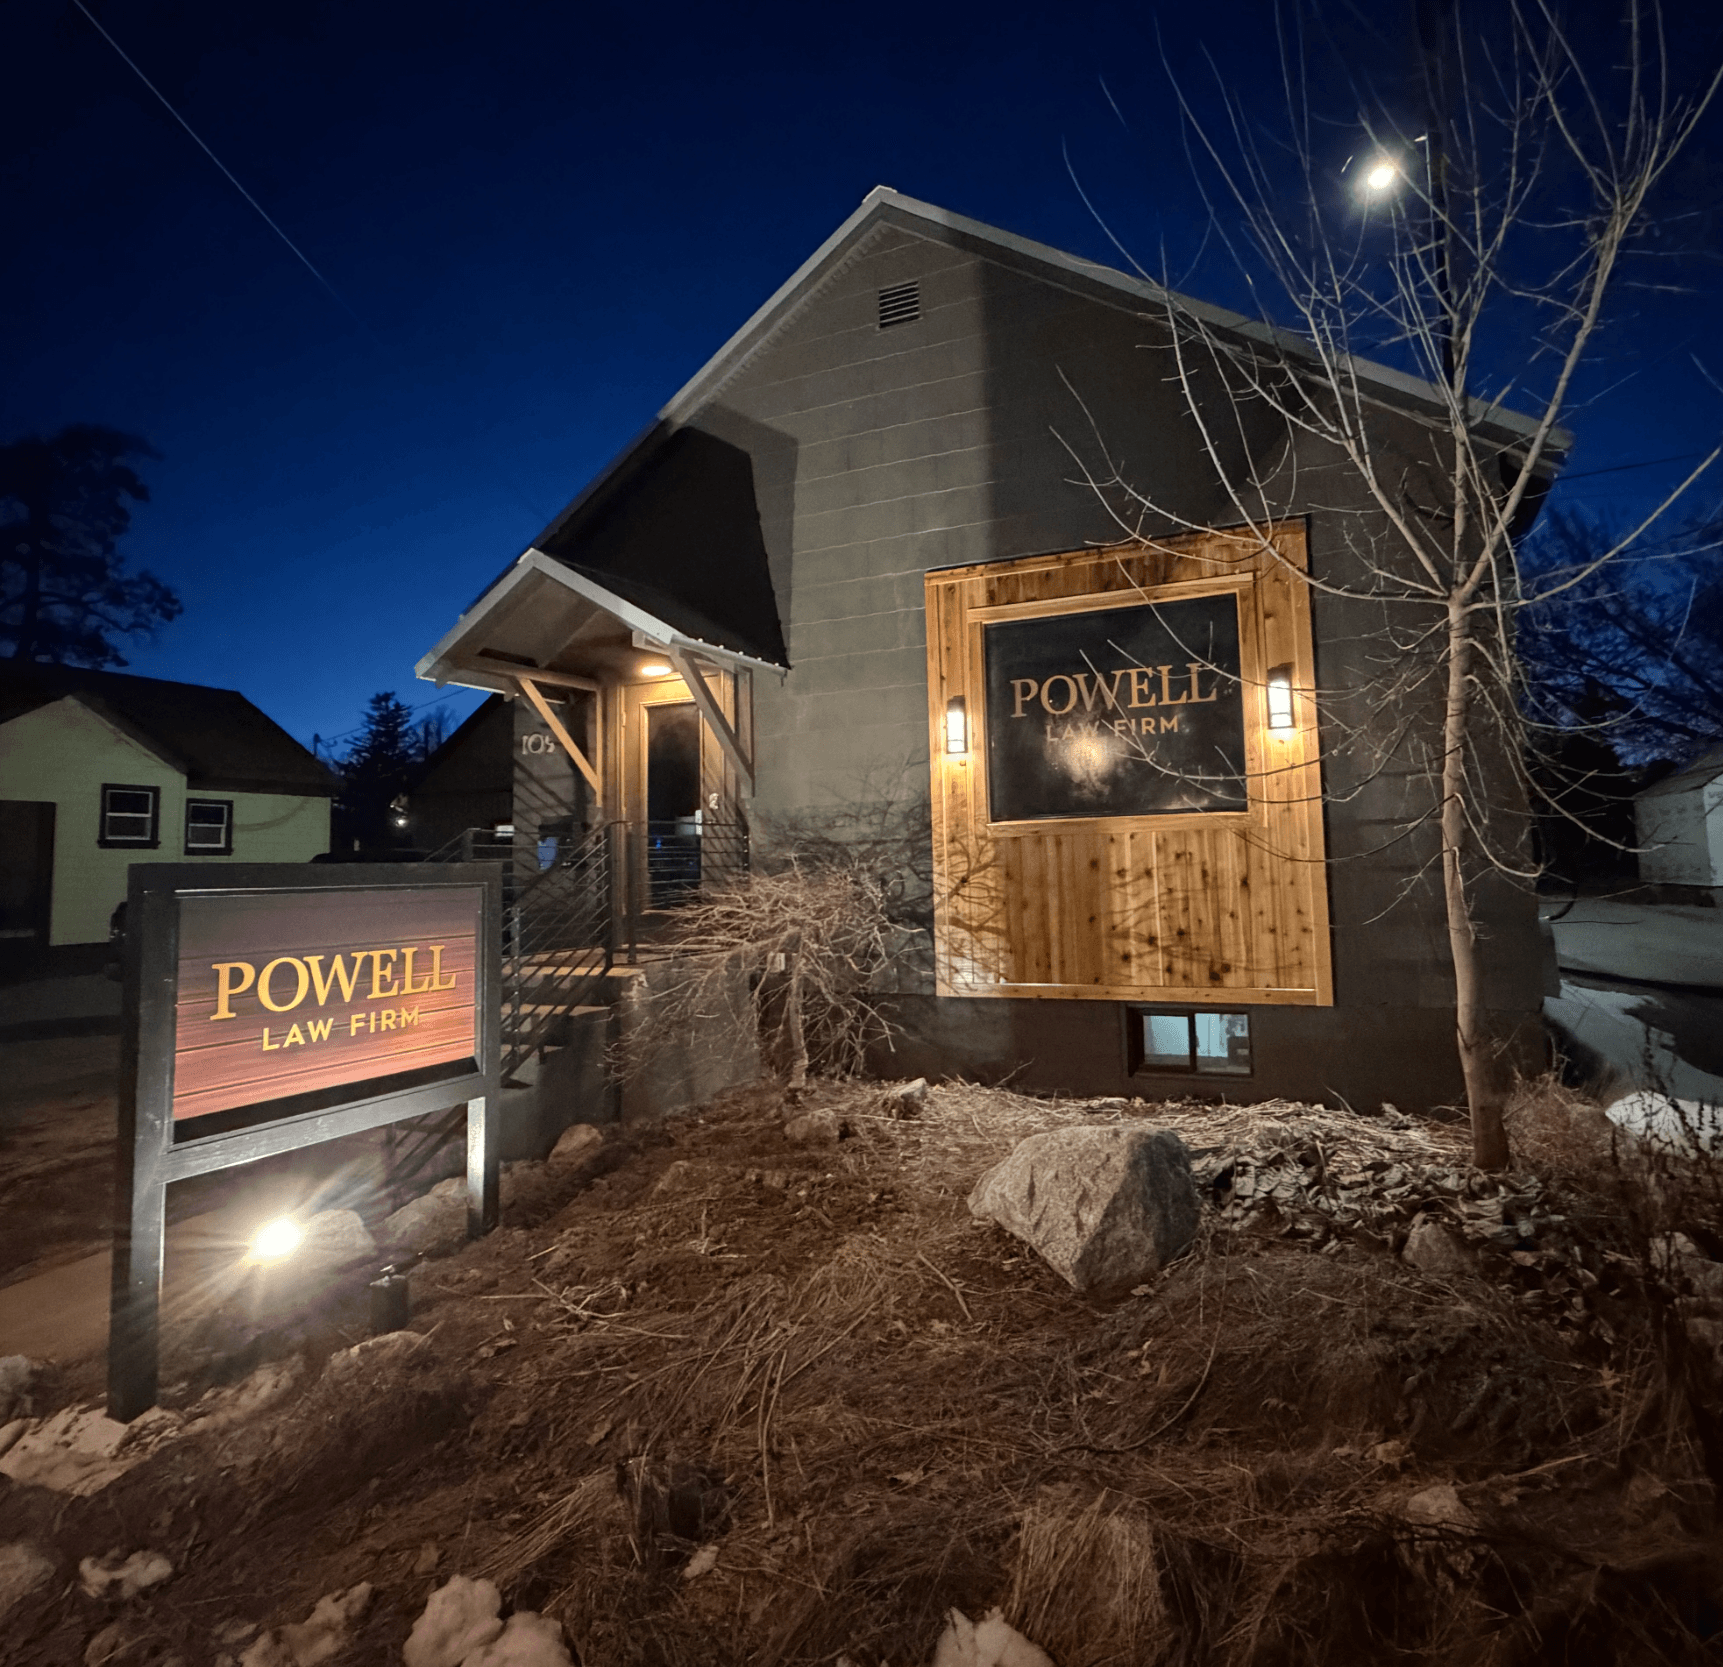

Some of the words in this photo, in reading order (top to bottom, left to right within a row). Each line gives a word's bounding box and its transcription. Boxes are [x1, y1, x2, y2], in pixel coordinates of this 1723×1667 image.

[1010, 662, 1217, 718] POWELL
[522, 733, 555, 755] 105
[1046, 721, 1099, 742] LAW
[1114, 715, 1178, 737] FIRM
[210, 945, 456, 1021] POWELL
[262, 1018, 334, 1051] LAW
[350, 1006, 420, 1036] FIRM
